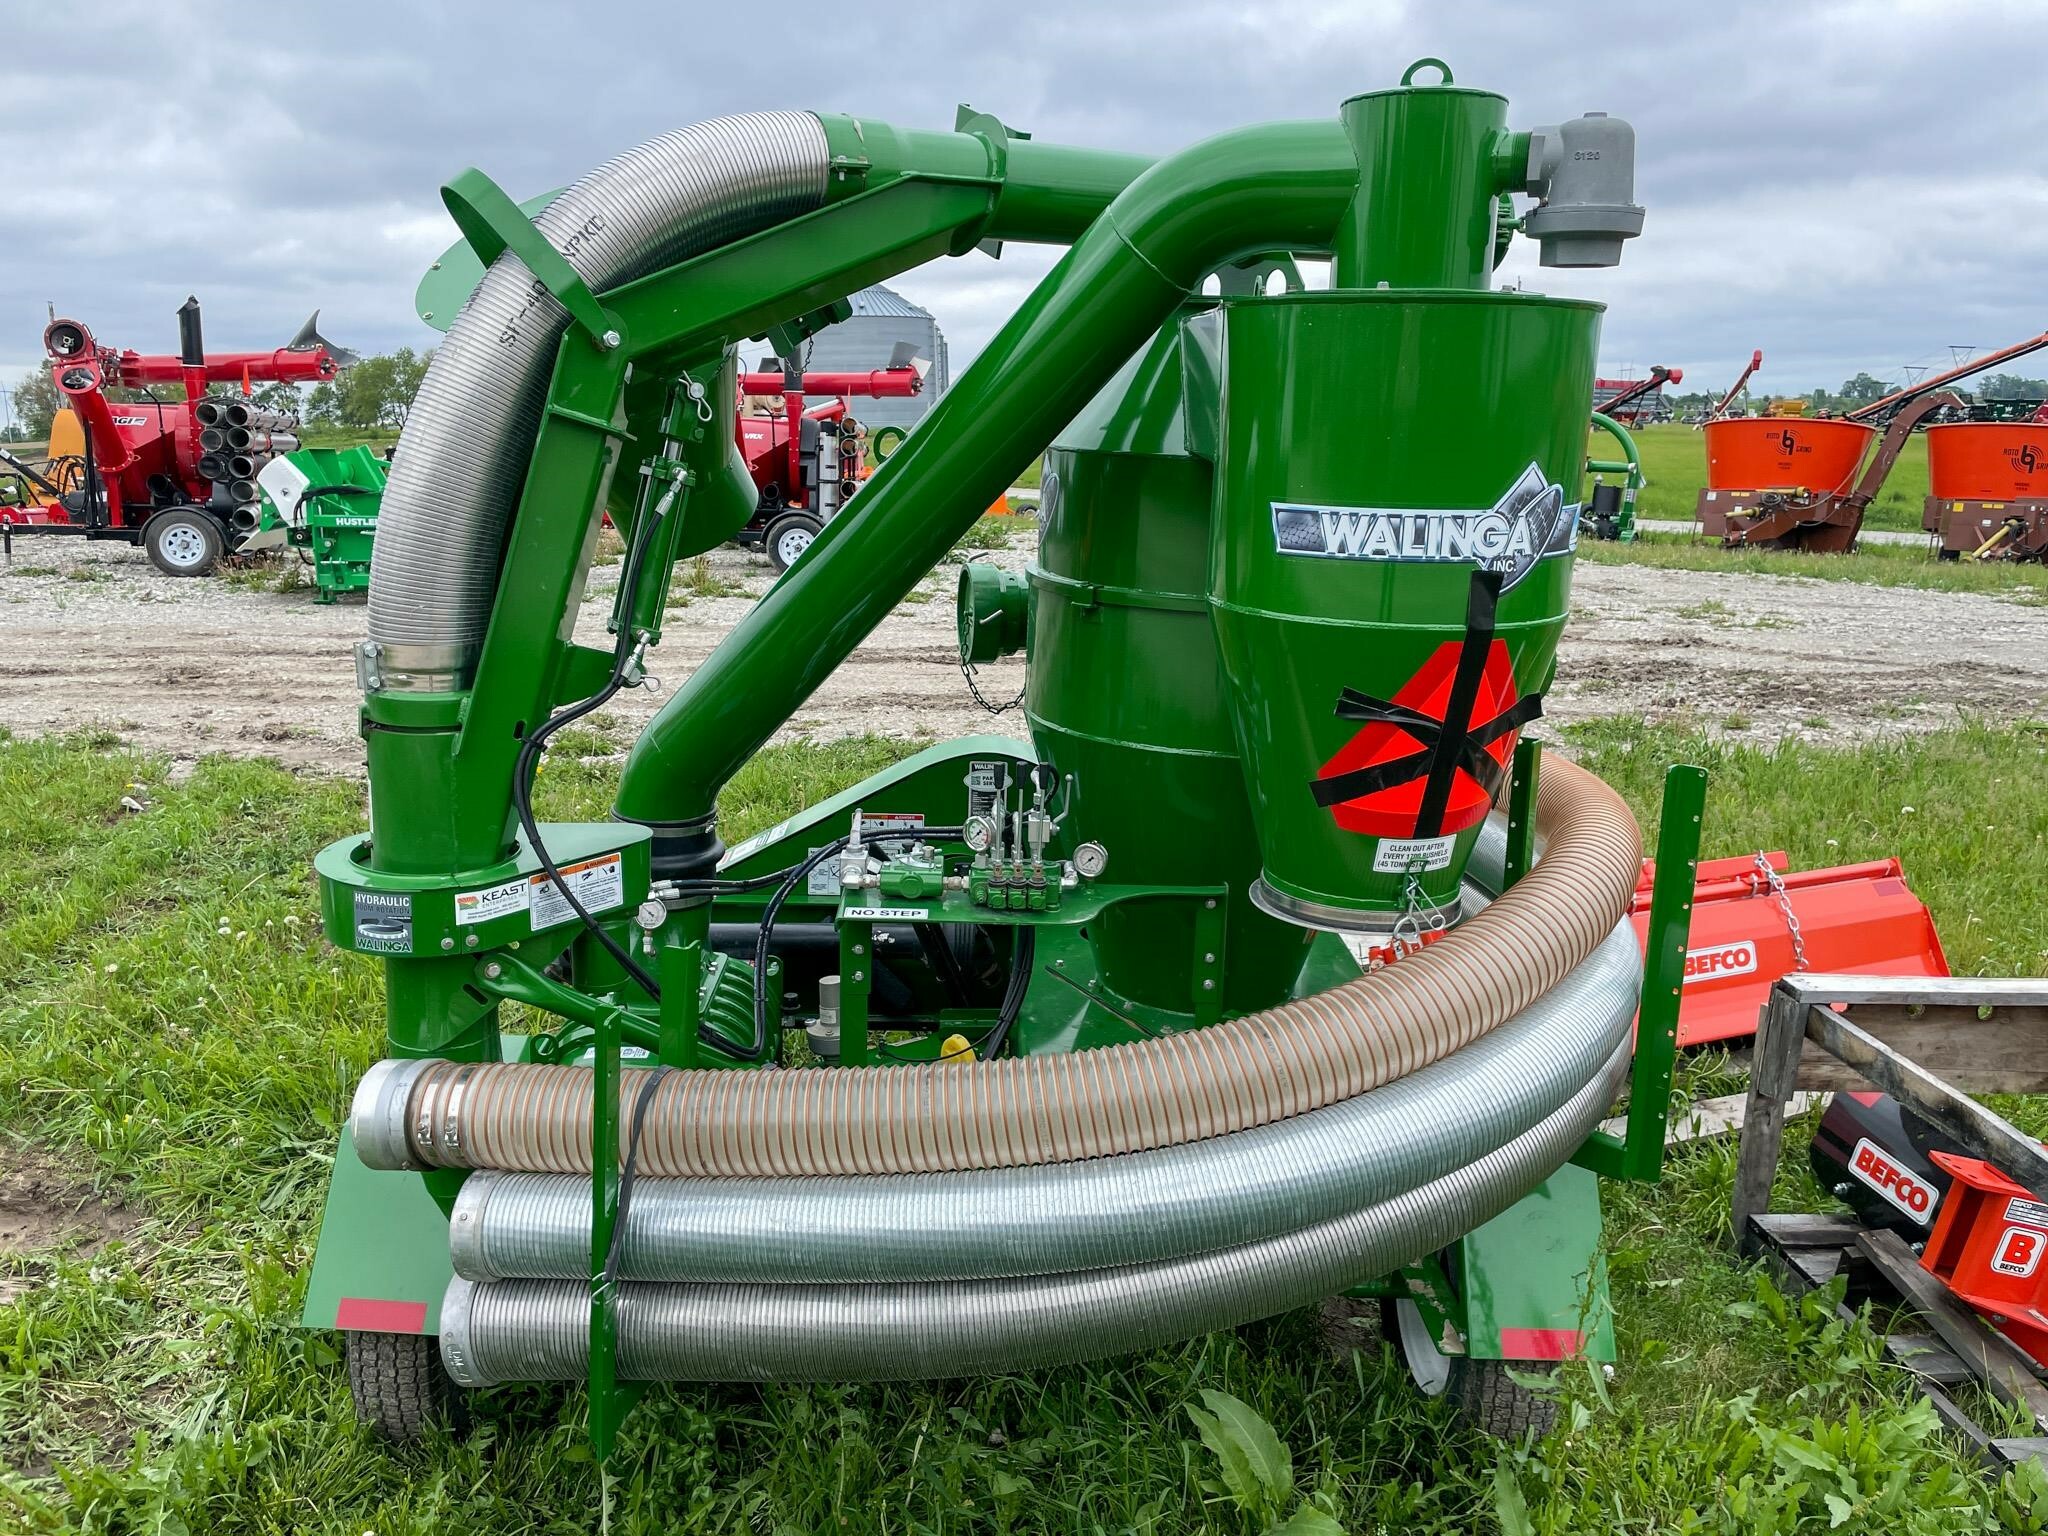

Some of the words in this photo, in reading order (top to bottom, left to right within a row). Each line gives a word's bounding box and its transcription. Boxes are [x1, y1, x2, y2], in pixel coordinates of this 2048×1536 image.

[2003, 448, 2019, 456] ROTO
[336, 517, 378, 526] HUSTLE
[1319, 512, 1533, 559] WALINGA
[1493, 560, 1517, 572] INC.
[1390, 844, 1411, 852] CLEAN
[1412, 844, 1426, 852] OUT
[1426, 842, 1445, 851] AFTER
[1383, 852, 1405, 860] EVERY
[1377, 860, 1389, 868] (45
[481, 882, 527, 904] KEAST
[355, 892, 410, 907] HYDRAULIC
[376, 906, 410, 915] ROTATION
[851, 909, 875, 917] NO
[879, 910, 921, 918] STEP
[356, 937, 411, 953] WALINGA
[1684, 947, 1751, 977] BEFCO
[1855, 1146, 1929, 1213] BEFCO
[2002, 1232, 2037, 1265] B
[1999, 1262, 2025, 1273] BEFCO
